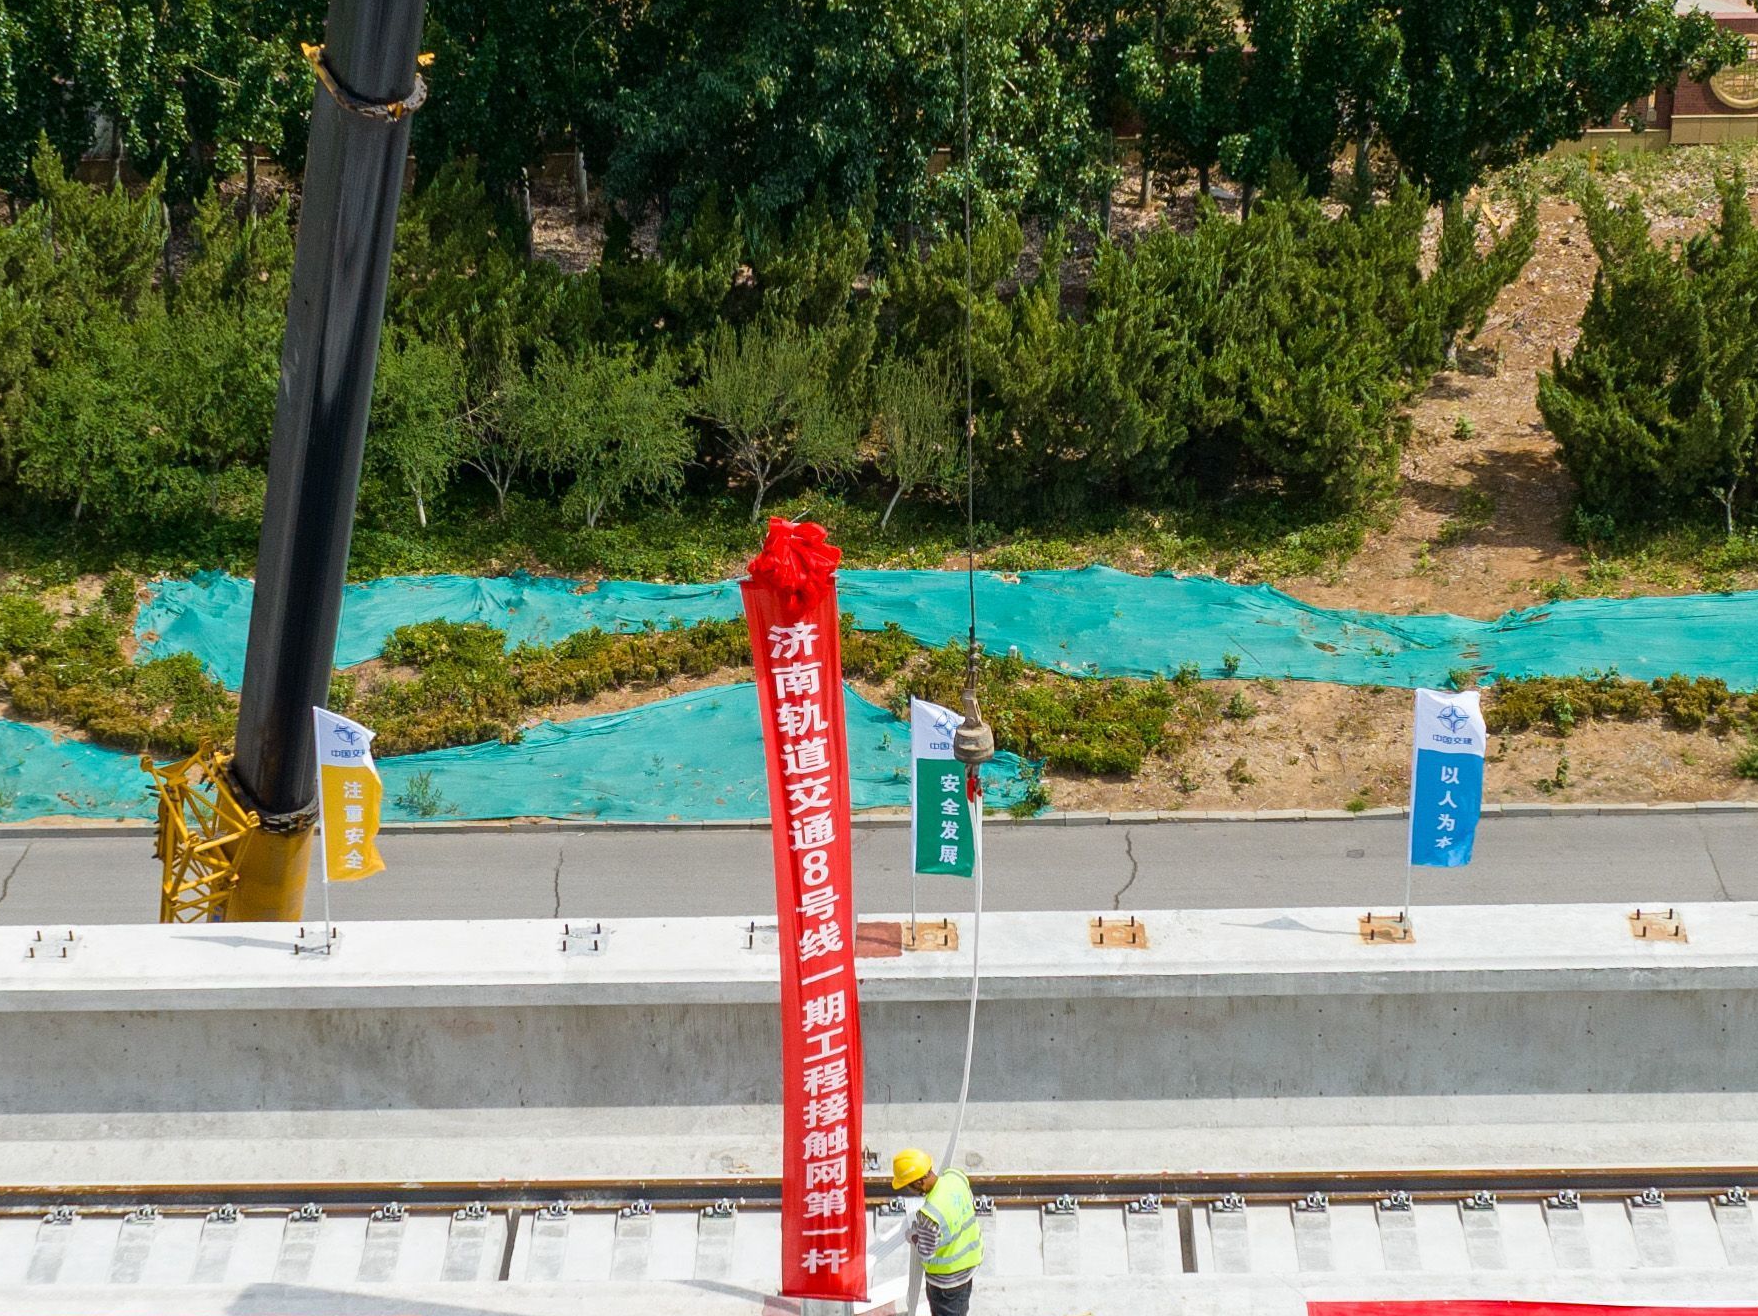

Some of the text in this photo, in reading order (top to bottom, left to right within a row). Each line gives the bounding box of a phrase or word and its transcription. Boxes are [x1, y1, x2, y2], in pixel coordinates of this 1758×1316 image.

[1432, 734, 1474, 746] 中国交建
[342, 780, 364, 871] 注重安全
[938, 773, 961, 866] 安全发展
[1434, 765, 1460, 850] 以人为本
[767, 621, 850, 1275] 济南轨道交通8号线一期工程接触网第一杆
